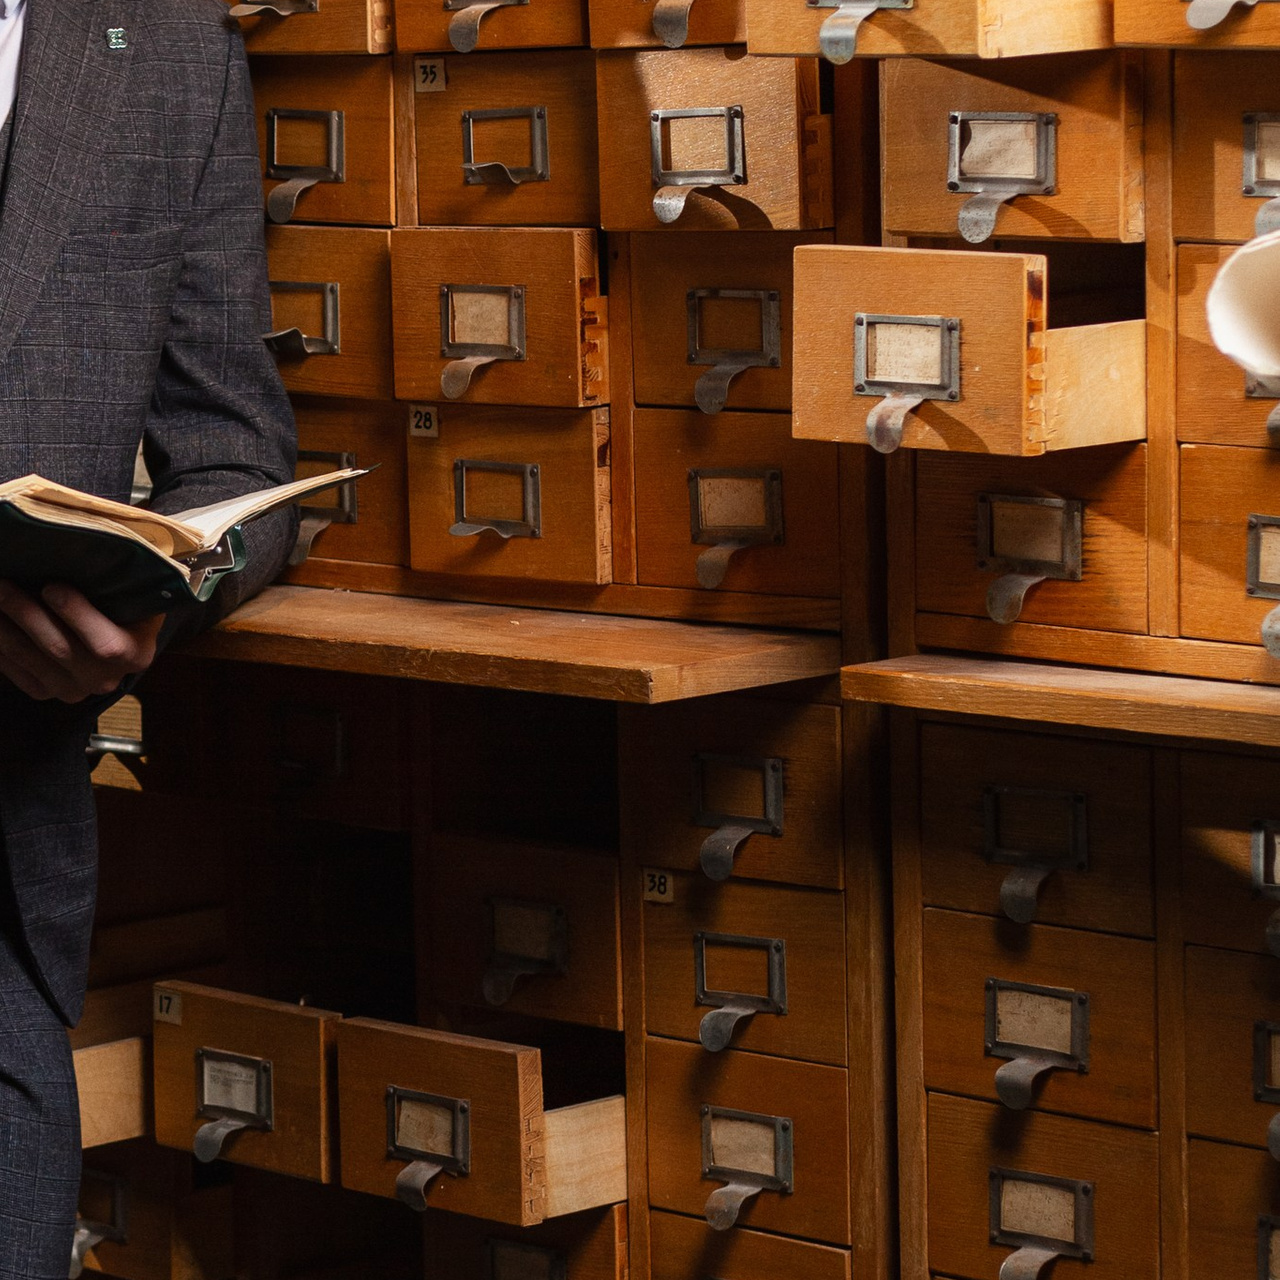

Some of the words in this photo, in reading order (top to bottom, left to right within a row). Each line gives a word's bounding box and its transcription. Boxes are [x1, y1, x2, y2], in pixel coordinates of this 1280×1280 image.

[420, 64, 437, 84] 35
[414, 410, 433, 430] 28
[646, 873, 667, 896] 38
[159, 994, 172, 1015] 17
